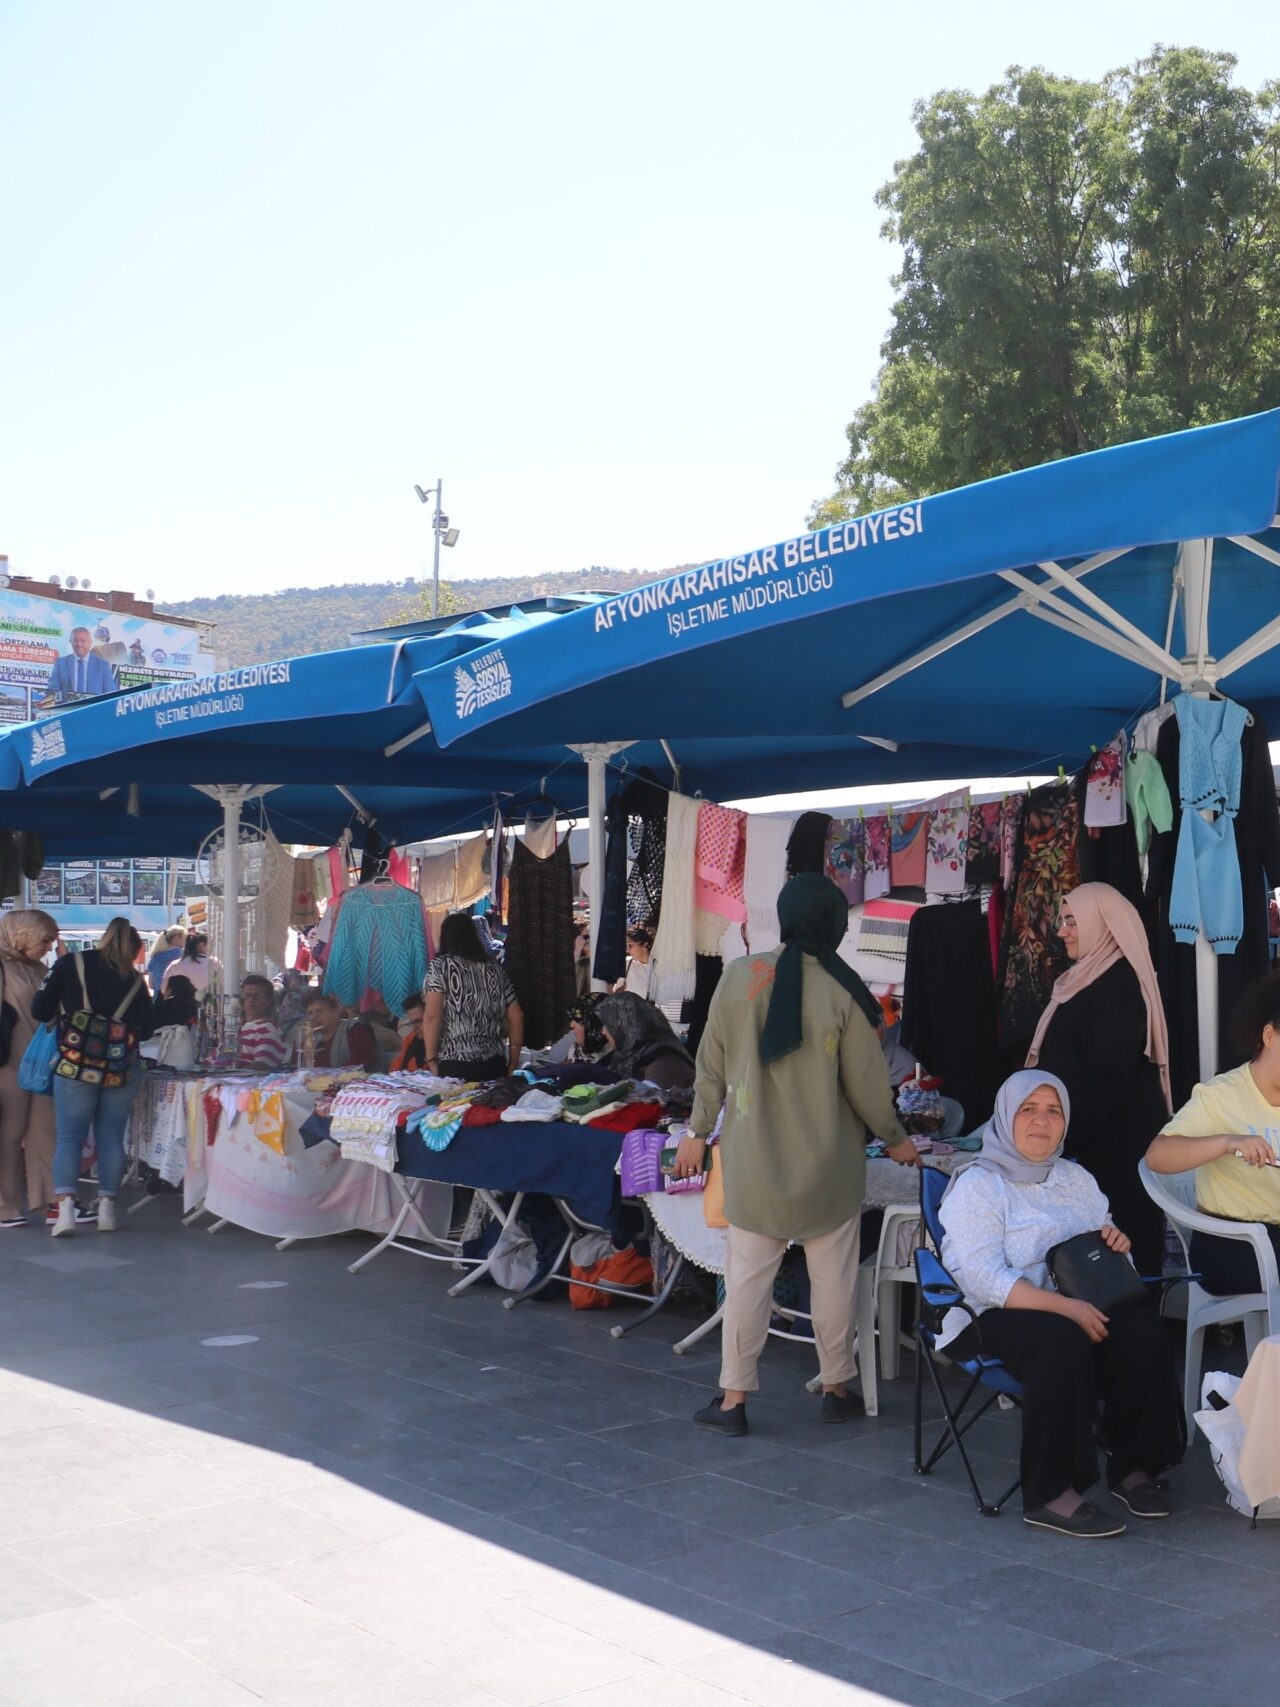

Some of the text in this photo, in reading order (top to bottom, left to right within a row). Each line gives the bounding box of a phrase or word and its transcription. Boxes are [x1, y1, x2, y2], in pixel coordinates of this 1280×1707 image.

[667, 564, 833, 638] İŞLETME MÜDÜRLÜĞÜ
[476, 661, 511, 691] SOSYAL
